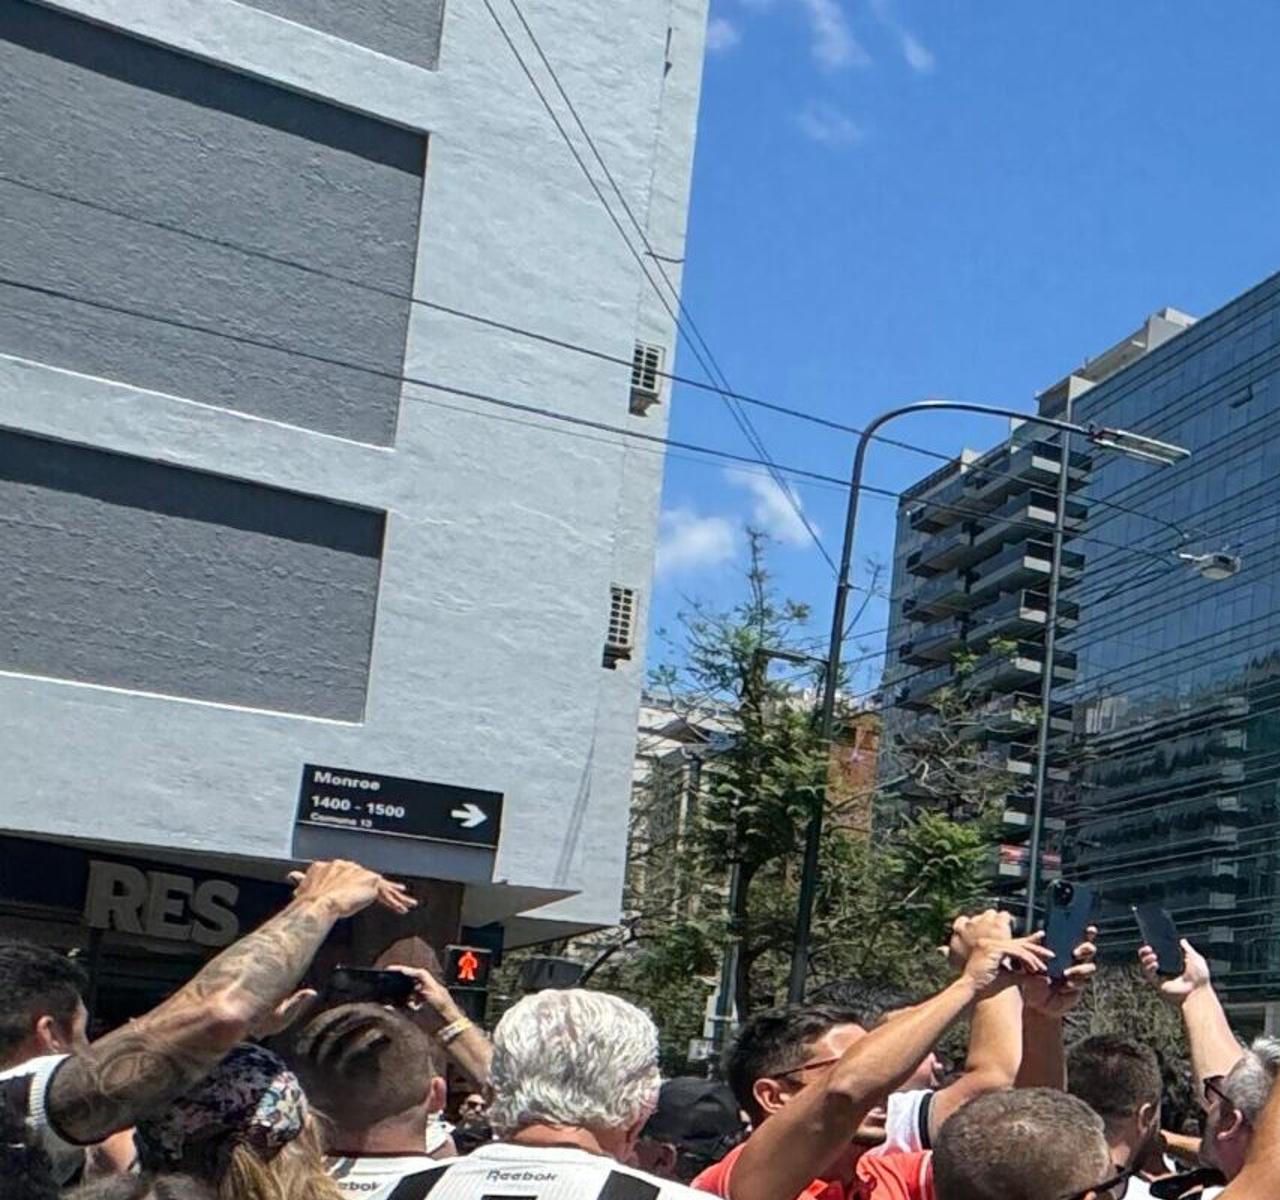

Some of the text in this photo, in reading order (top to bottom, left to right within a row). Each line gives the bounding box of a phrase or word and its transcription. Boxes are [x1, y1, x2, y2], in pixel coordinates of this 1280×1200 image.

[313, 771, 381, 791] Monroe
[311, 795, 352, 811] 1400
[366, 802, 405, 818] 1500
[486, 1169, 557, 1182] Reebok
